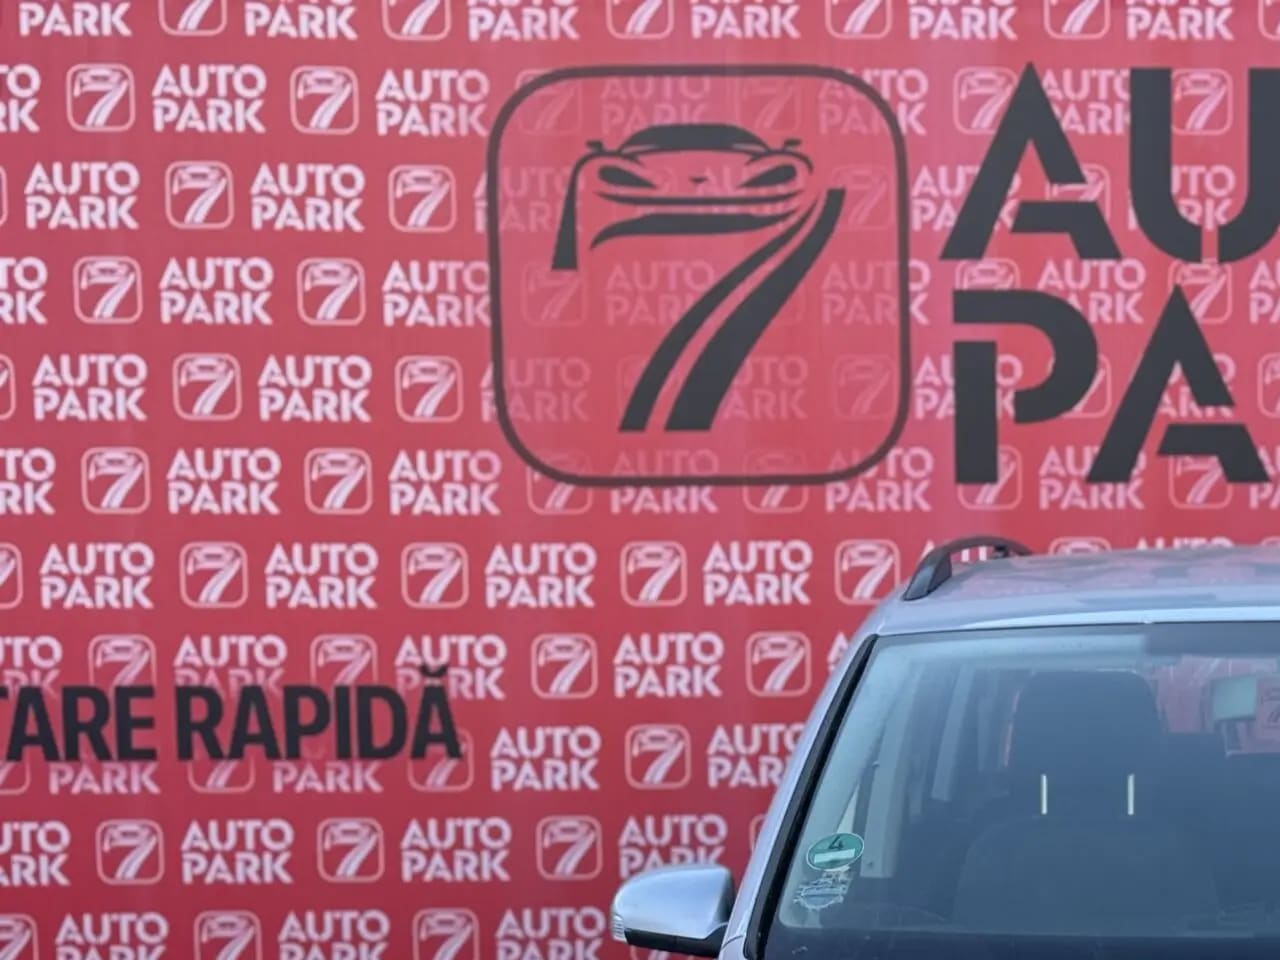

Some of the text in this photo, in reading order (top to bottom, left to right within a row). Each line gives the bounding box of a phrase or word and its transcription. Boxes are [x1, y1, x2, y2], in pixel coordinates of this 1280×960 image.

[19, 2, 131, 36] PARK
[469, 7, 578, 41] PARK
[910, 5, 1016, 39] PARK
[152, 64, 266, 98] AUTO
[376, 69, 489, 101] AUTO
[153, 97, 265, 133] PARK
[377, 101, 488, 137] PARK
[24, 161, 140, 196] AUTO
[251, 163, 365, 197] AUTO
[26, 194, 138, 229] PARK
[252, 196, 364, 232] PARK
[159, 257, 273, 291] AUTO
[382, 261, 491, 295] AUTO
[1037, 258, 1145, 290] AUTO
[160, 290, 272, 325] PARK
[384, 293, 491, 327] PARK
[32, 354, 147, 388] AUTO
[258, 355, 372, 388] AUTO
[34, 386, 146, 421] PARK
[259, 387, 371, 422] PARK
[167, 448, 281, 481] AUTO
[389, 450, 501, 482] AUTO
[168, 480, 280, 514] PARK
[390, 481, 500, 515] PARK
[1040, 478, 1144, 509] PARK
[40, 542, 154, 576] AUTO
[265, 543, 378, 576] AUTO
[485, 543, 597, 576] AUTO
[703, 540, 812, 572] AUTO
[41, 575, 153, 609] PARK
[266, 575, 377, 609] PARK
[486, 574, 594, 608] PARK
[704, 572, 810, 605] PARK
[174, 635, 287, 668] AUTO
[395, 634, 507, 668] AUTO
[613, 632, 724, 665] AUTO
[614, 664, 721, 698] PARK
[0, 664, 462, 762] ARE RAPIDĂ
[490, 726, 601, 759] AUTO
[49, 761, 160, 794] PARK
[491, 757, 599, 791] PARK
[181, 819, 294, 852] AUTO
[401, 817, 511, 850] AUTO
[618, 814, 728, 846] AUTO
[182, 850, 292, 884] PARK
[402, 848, 510, 882] PARK
[55, 912, 169, 945] AUTO
[495, 906, 606, 939] AUTO
